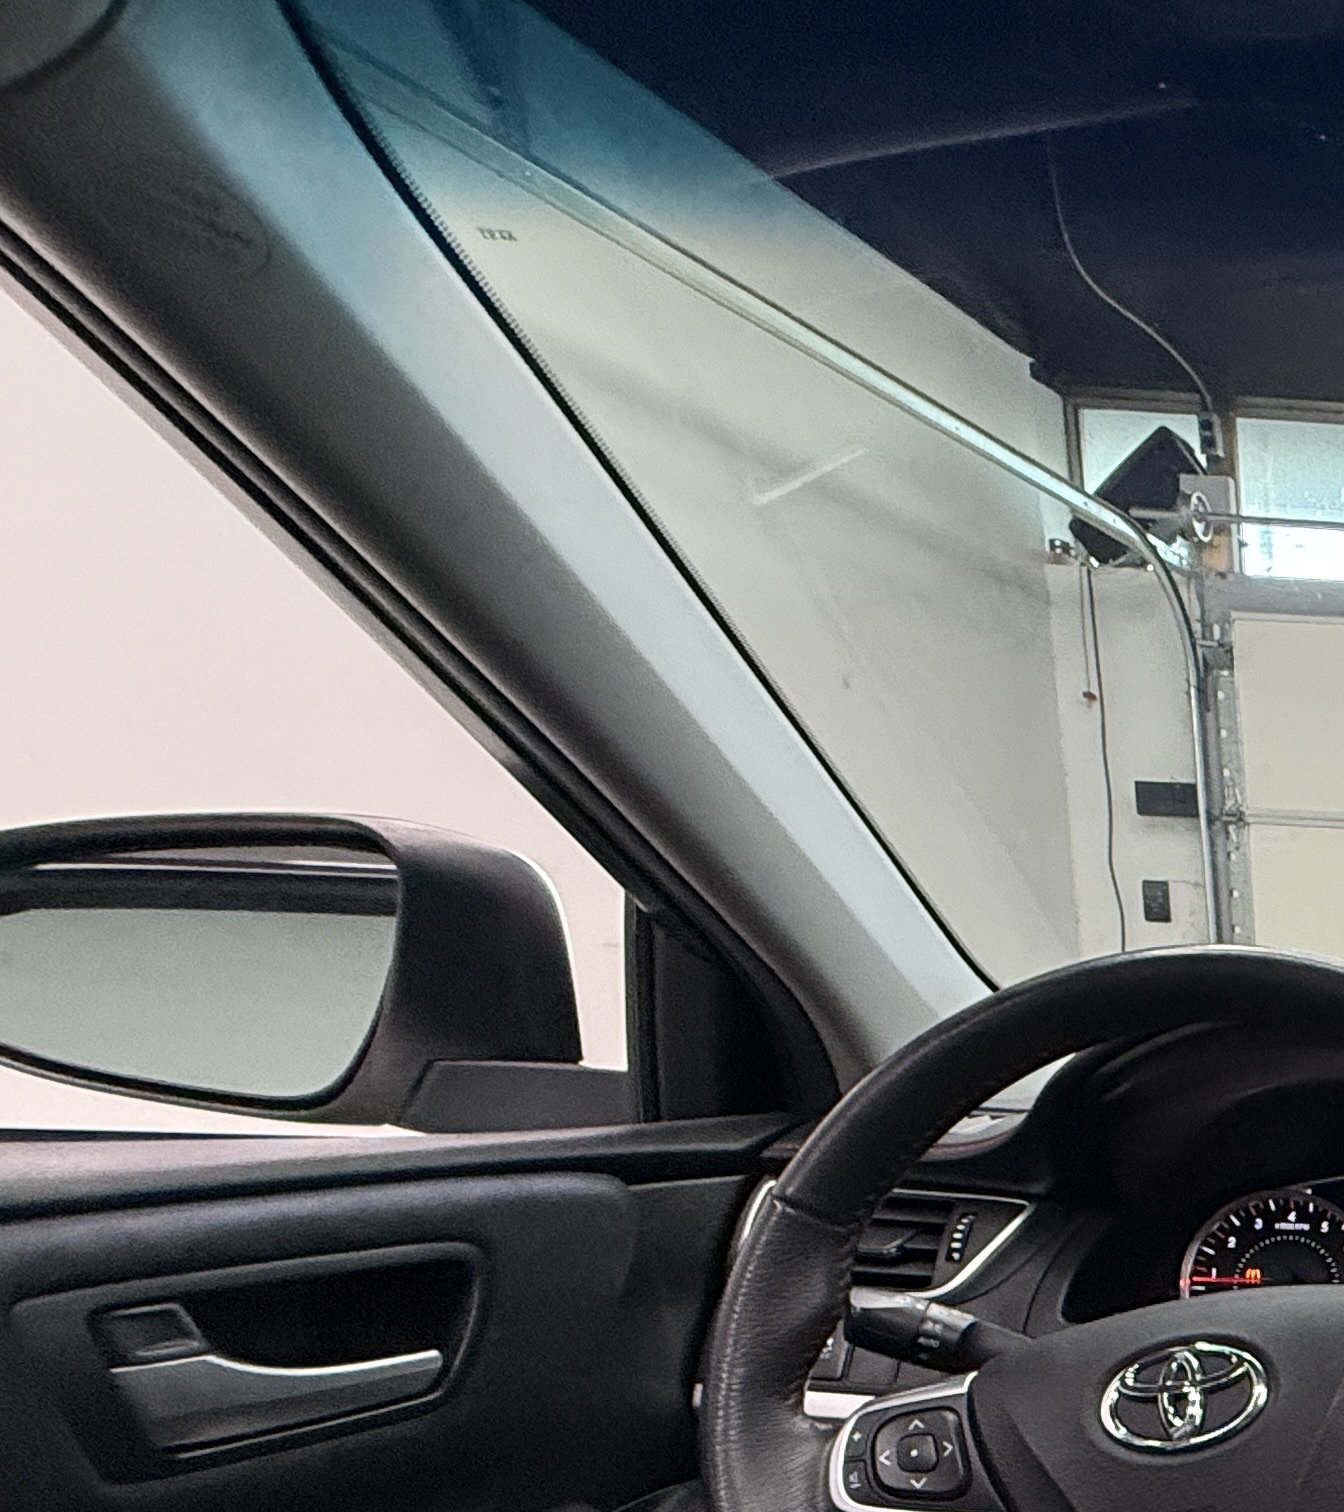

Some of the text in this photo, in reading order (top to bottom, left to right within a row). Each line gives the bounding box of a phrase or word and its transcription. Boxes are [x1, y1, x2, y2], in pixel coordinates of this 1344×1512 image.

[1287, 1210, 1297, 1223] 4
[1254, 1217, 1264, 1231] 3
[1320, 1220, 1330, 1234] 5
[1226, 1236, 1237, 1249] 2
